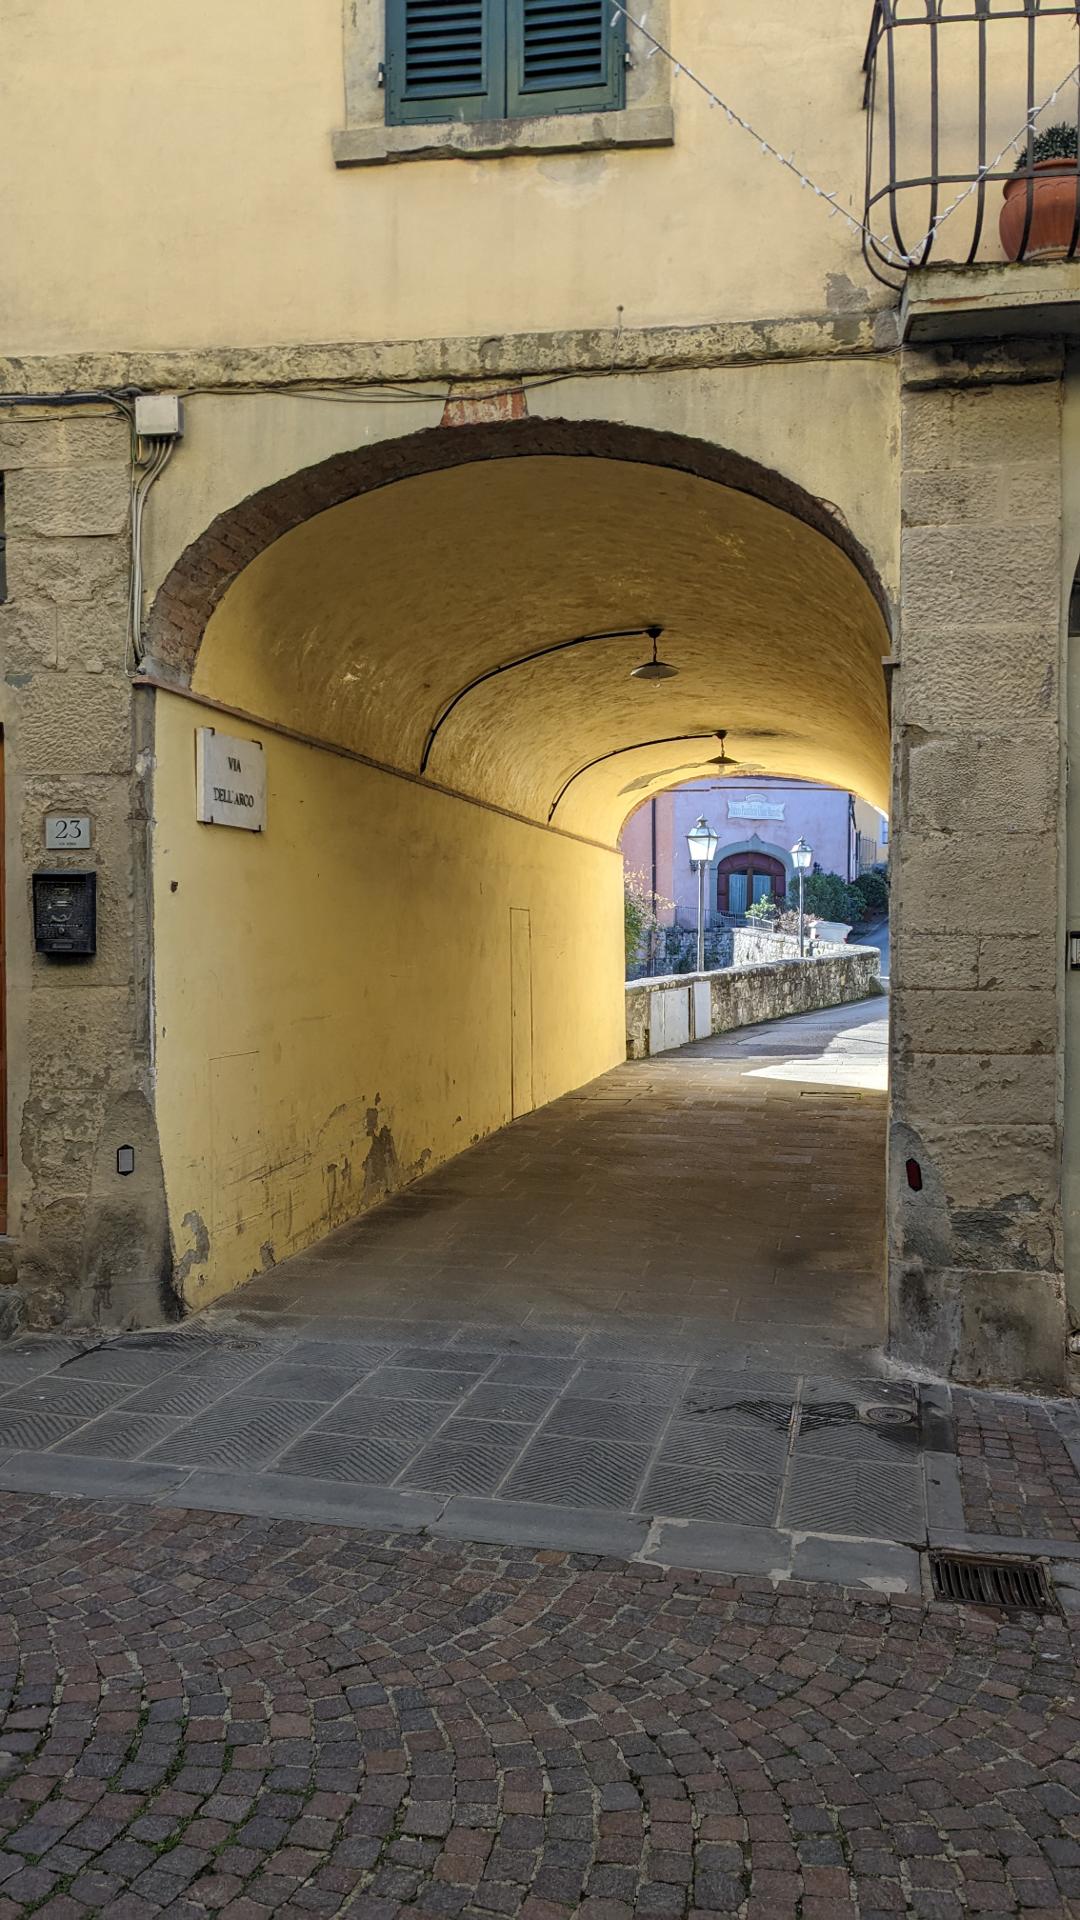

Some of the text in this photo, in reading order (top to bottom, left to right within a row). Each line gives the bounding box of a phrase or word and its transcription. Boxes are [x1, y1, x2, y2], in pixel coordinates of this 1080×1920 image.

[227, 757, 242, 773] VIA
[213, 787, 255, 808] DELL'ARCO
[55, 819, 82, 839] 23
